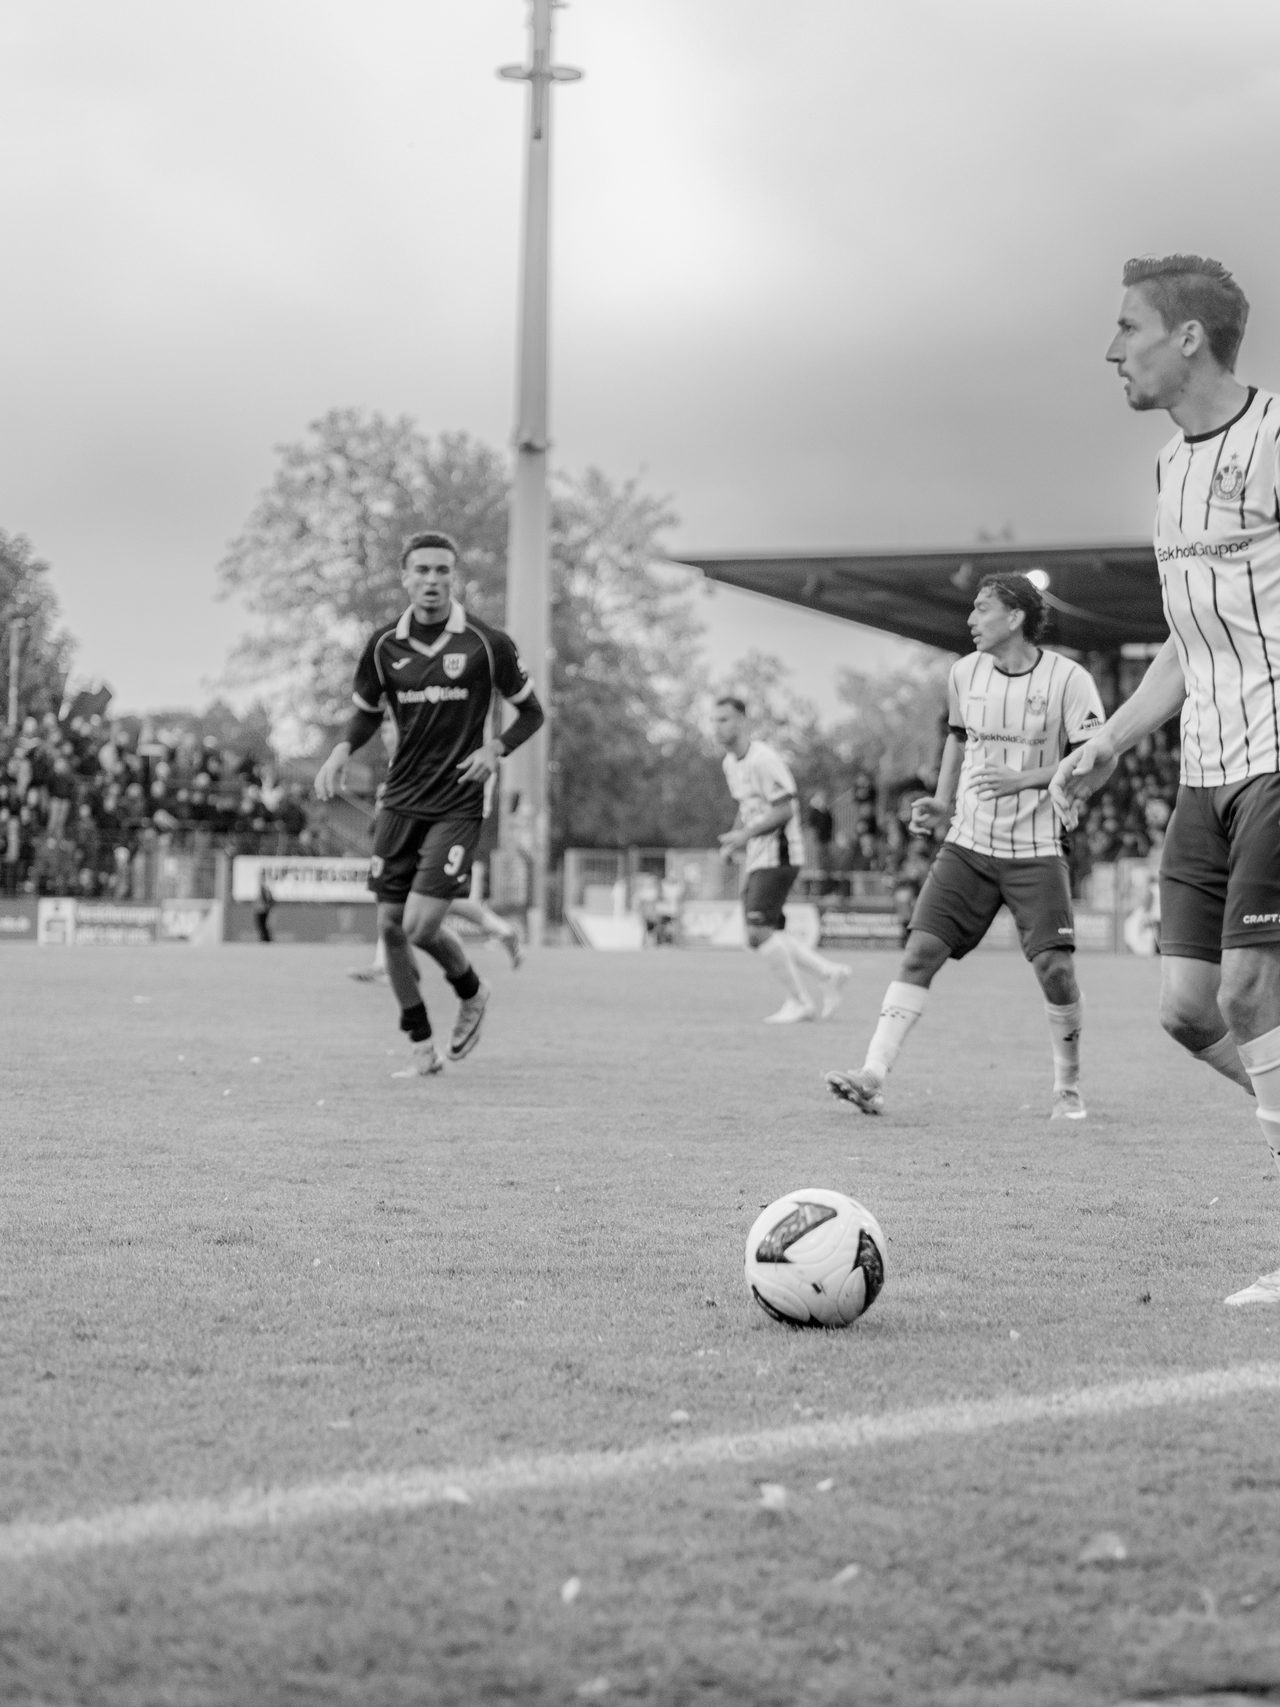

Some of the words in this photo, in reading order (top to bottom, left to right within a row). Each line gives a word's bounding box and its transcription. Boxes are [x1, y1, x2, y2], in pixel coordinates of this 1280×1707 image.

[1158, 541, 1249, 562] EckhodGruppe
[444, 844, 465, 876] 9
[1243, 913, 1278, 924] CRAFT
